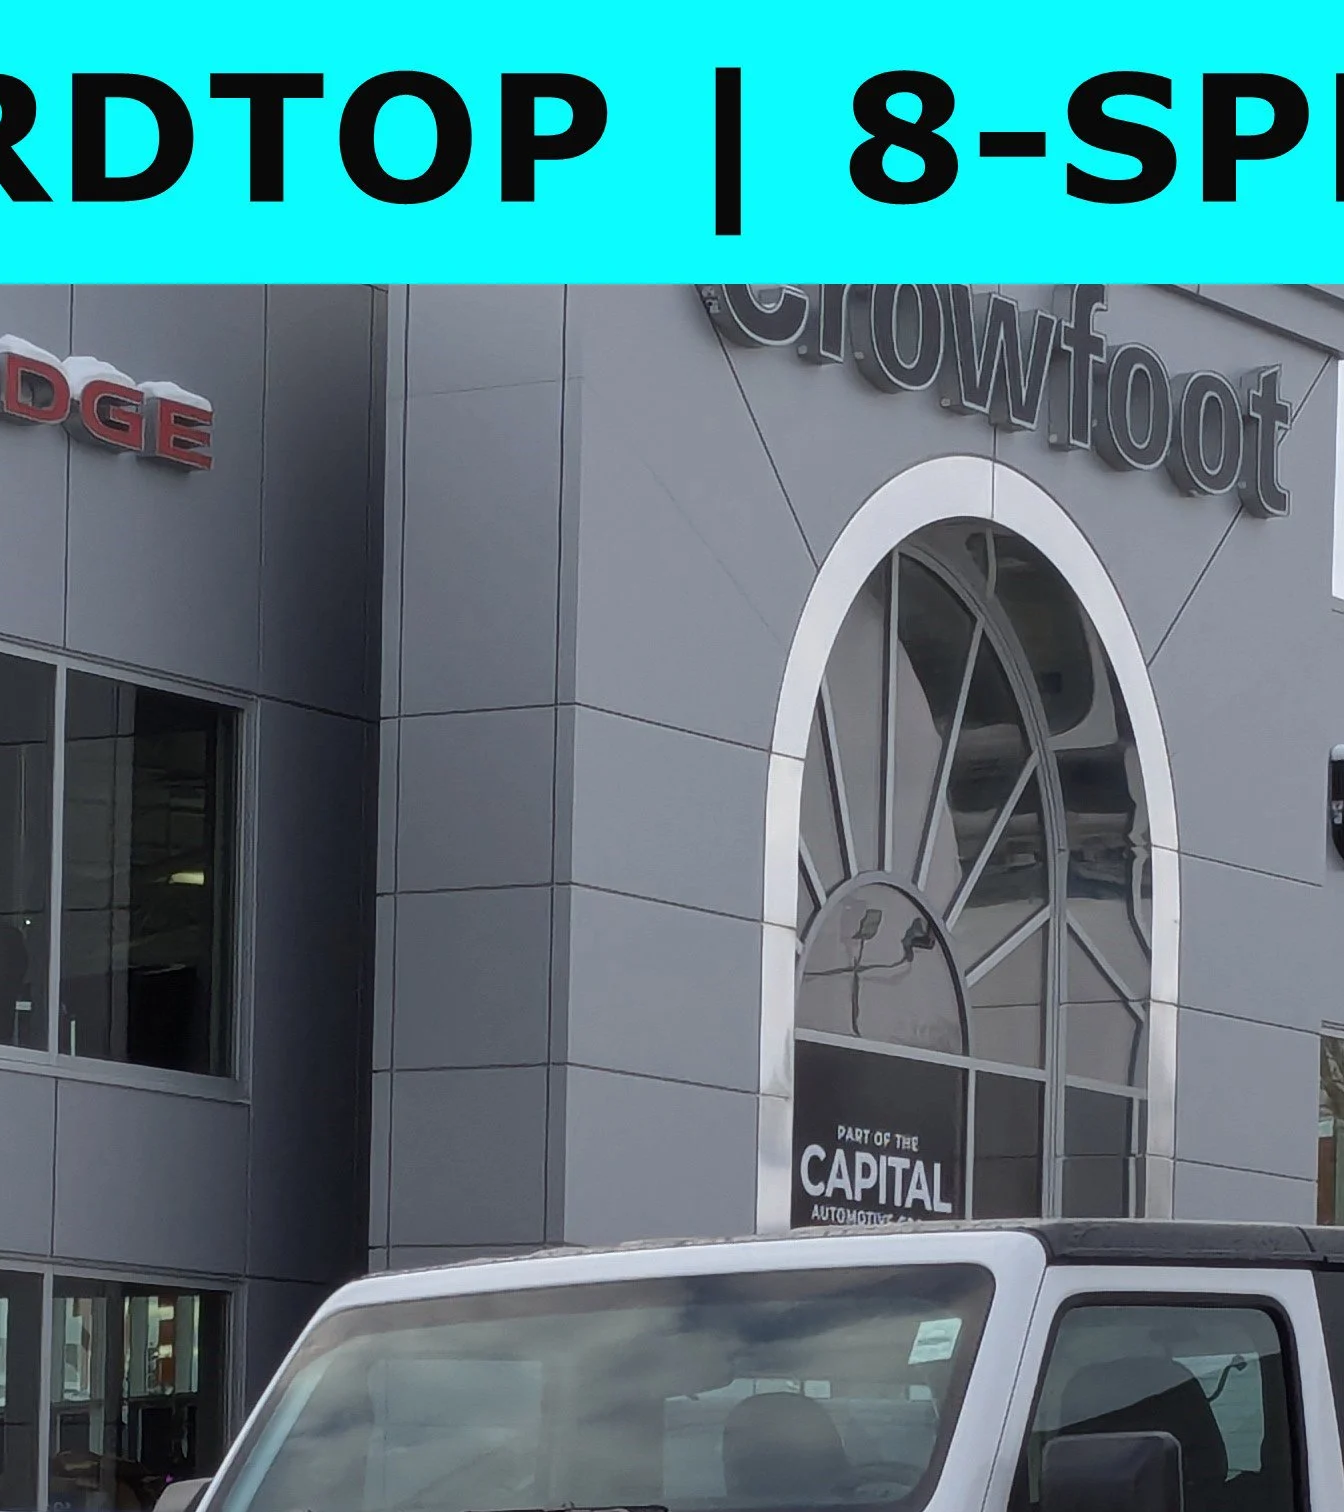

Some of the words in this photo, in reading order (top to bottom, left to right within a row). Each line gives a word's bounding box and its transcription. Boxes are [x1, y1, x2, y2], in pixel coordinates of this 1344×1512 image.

[837, 1125, 870, 1145] PART
[873, 1130, 891, 1148] OF
[894, 1133, 919, 1153] THE
[800, 1144, 953, 1214] CAPITAL
